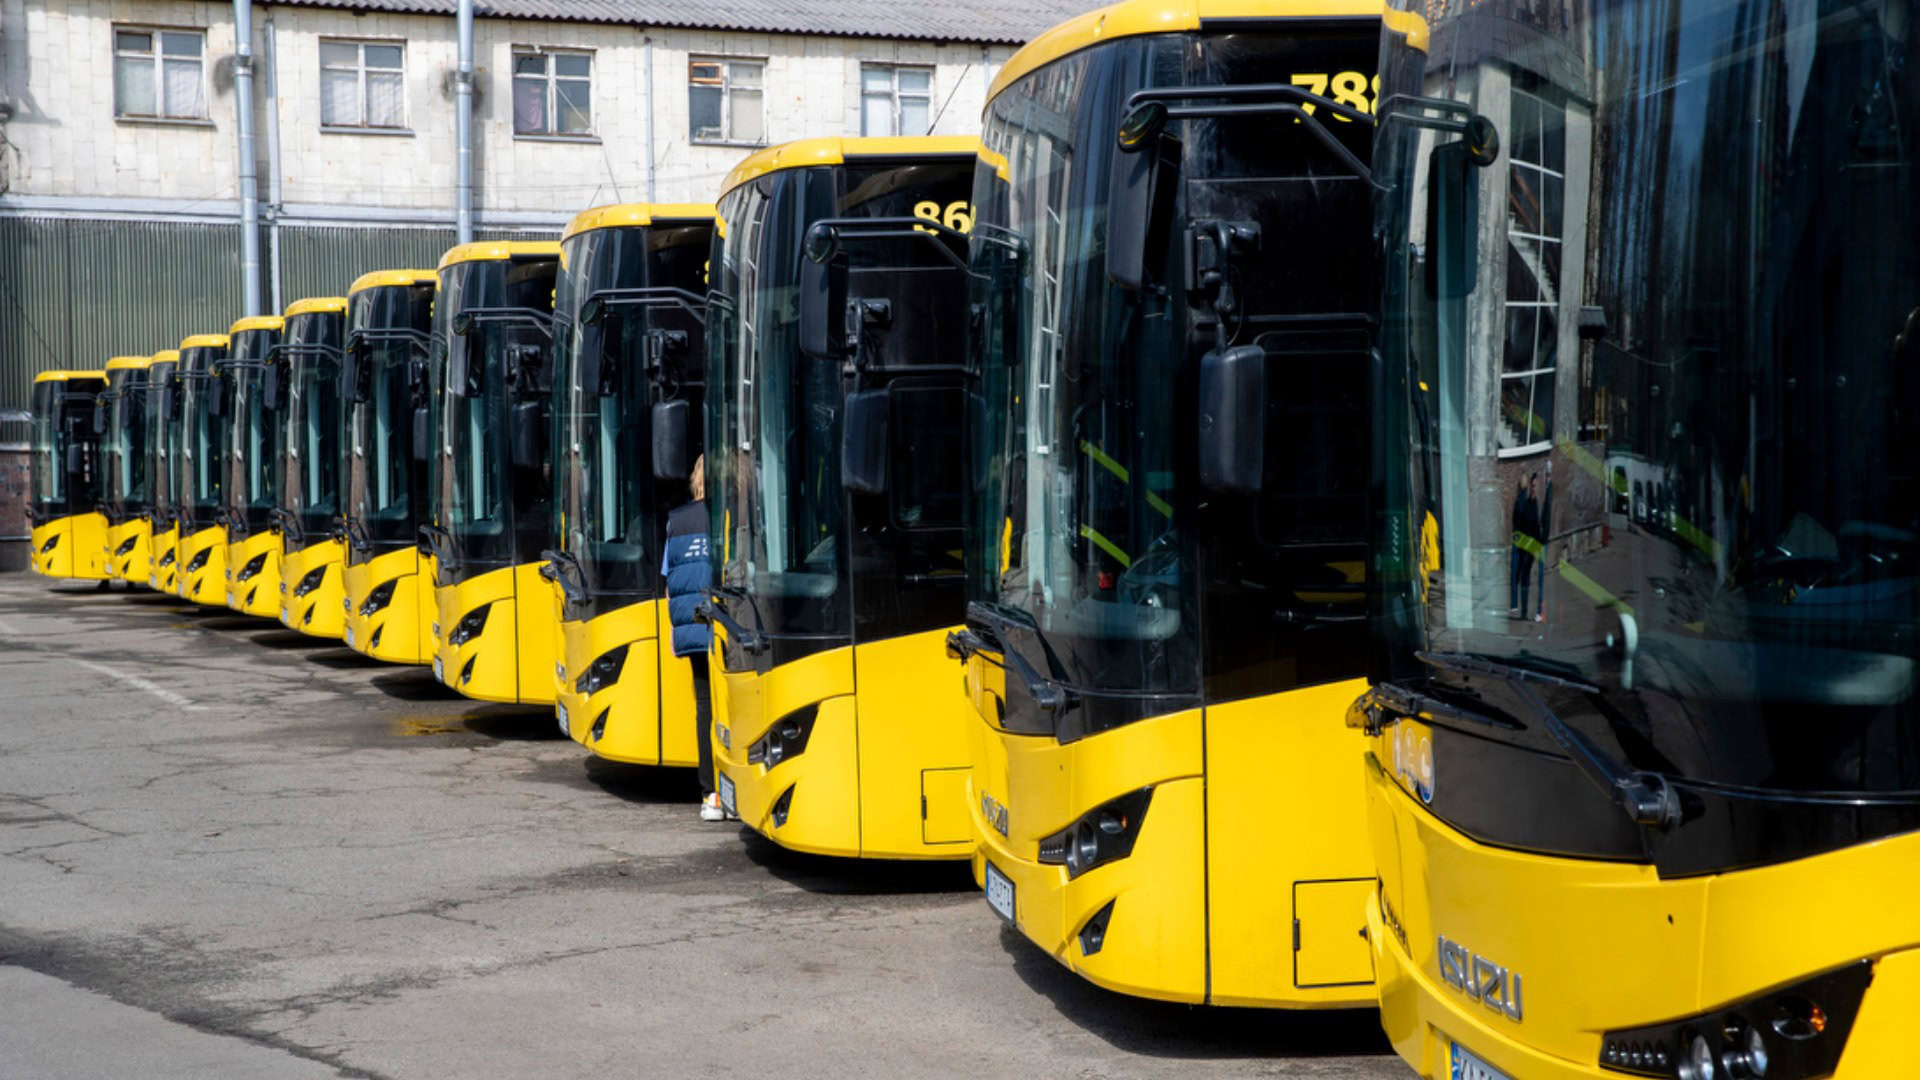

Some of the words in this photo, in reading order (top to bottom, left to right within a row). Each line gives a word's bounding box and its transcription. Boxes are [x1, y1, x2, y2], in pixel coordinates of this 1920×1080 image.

[1291, 71, 1379, 125] 78
[914, 201, 976, 238] 86
[1438, 934, 1523, 1022] ISUZU
